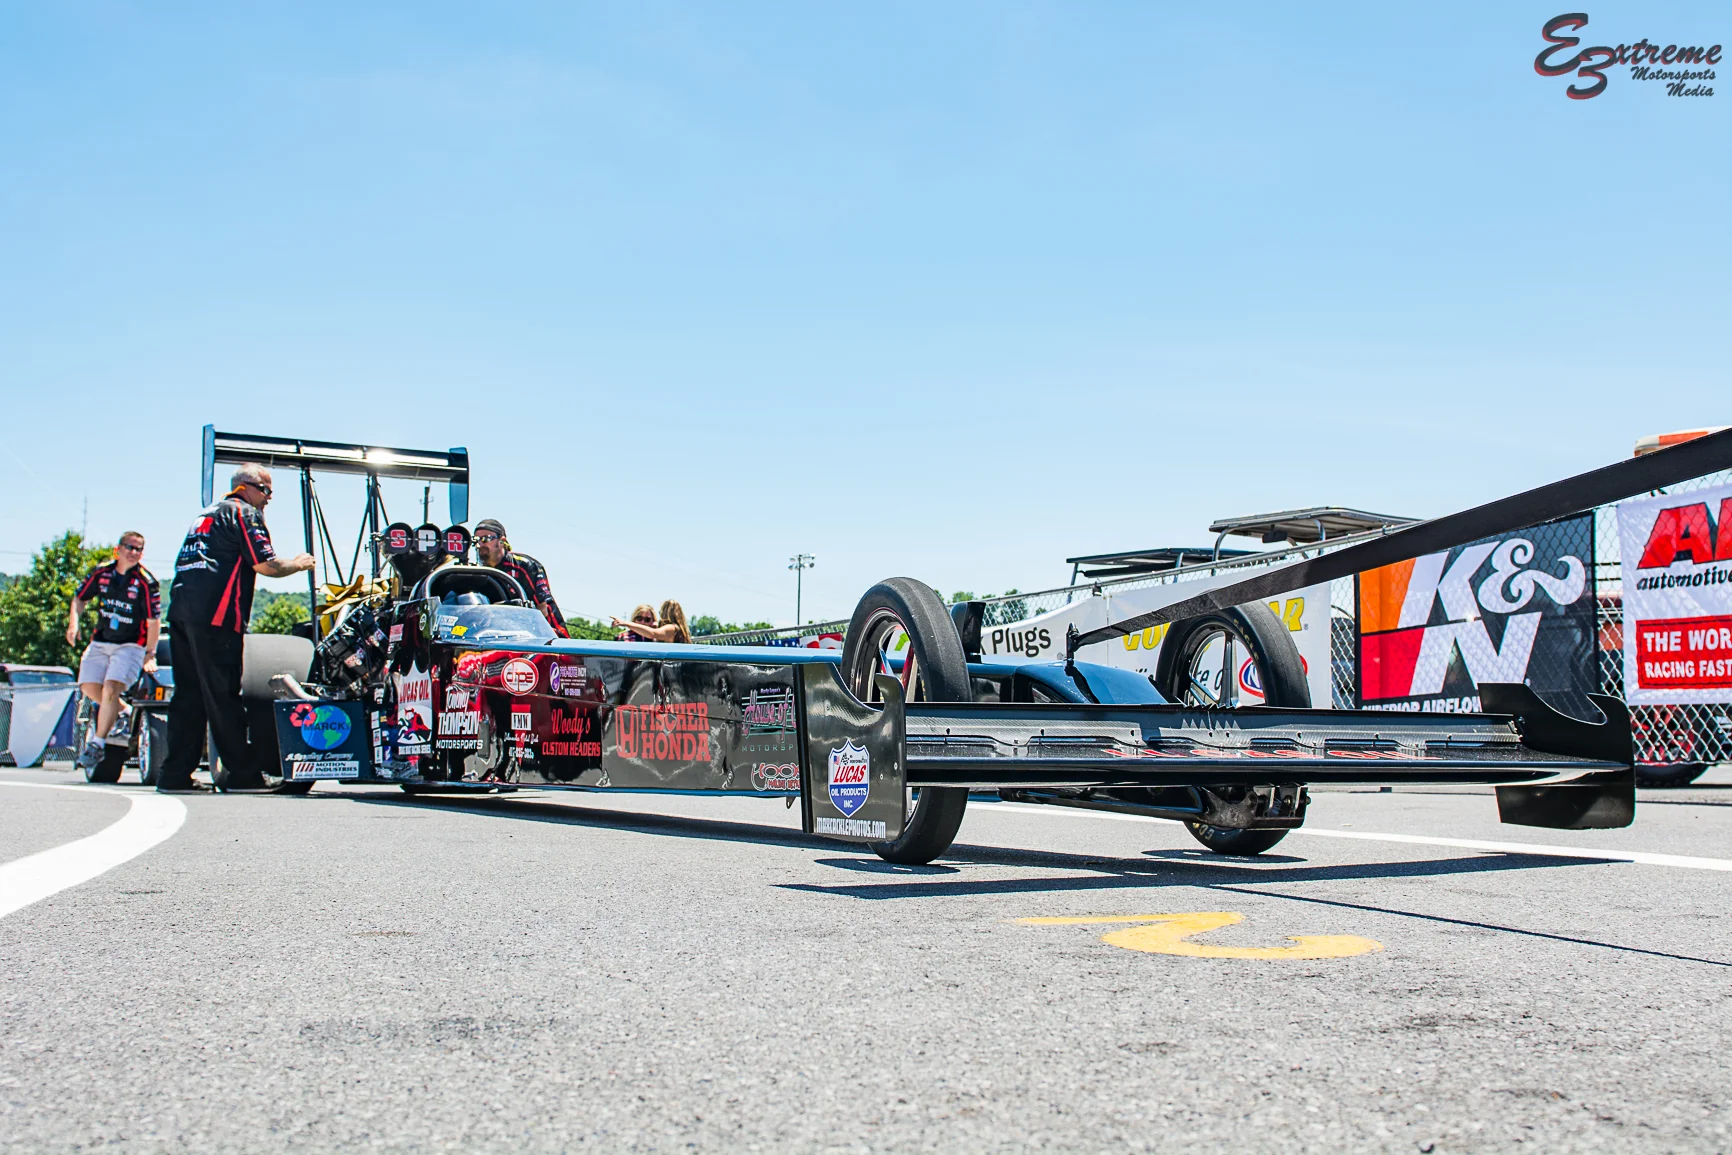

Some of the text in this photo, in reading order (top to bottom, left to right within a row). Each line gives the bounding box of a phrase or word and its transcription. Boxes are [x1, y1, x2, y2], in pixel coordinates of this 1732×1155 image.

[991, 627, 1051, 658] Plugs
[1643, 631, 1682, 652] THE
[1644, 660, 1695, 678] RACING
[420, 679, 430, 701] OIL
[438, 711, 480, 736] THOMPSON
[552, 708, 591, 742] Woody's
[640, 702, 709, 731] FISCHER
[436, 740, 483, 750] MOTORSPORTS
[542, 742, 568, 756] CUSTOM
[569, 743, 601, 757] HEADERS
[641, 732, 711, 762] HONDA
[833, 764, 866, 783] LUCAS
[831, 787, 867, 796] OIL PRODUCTS
